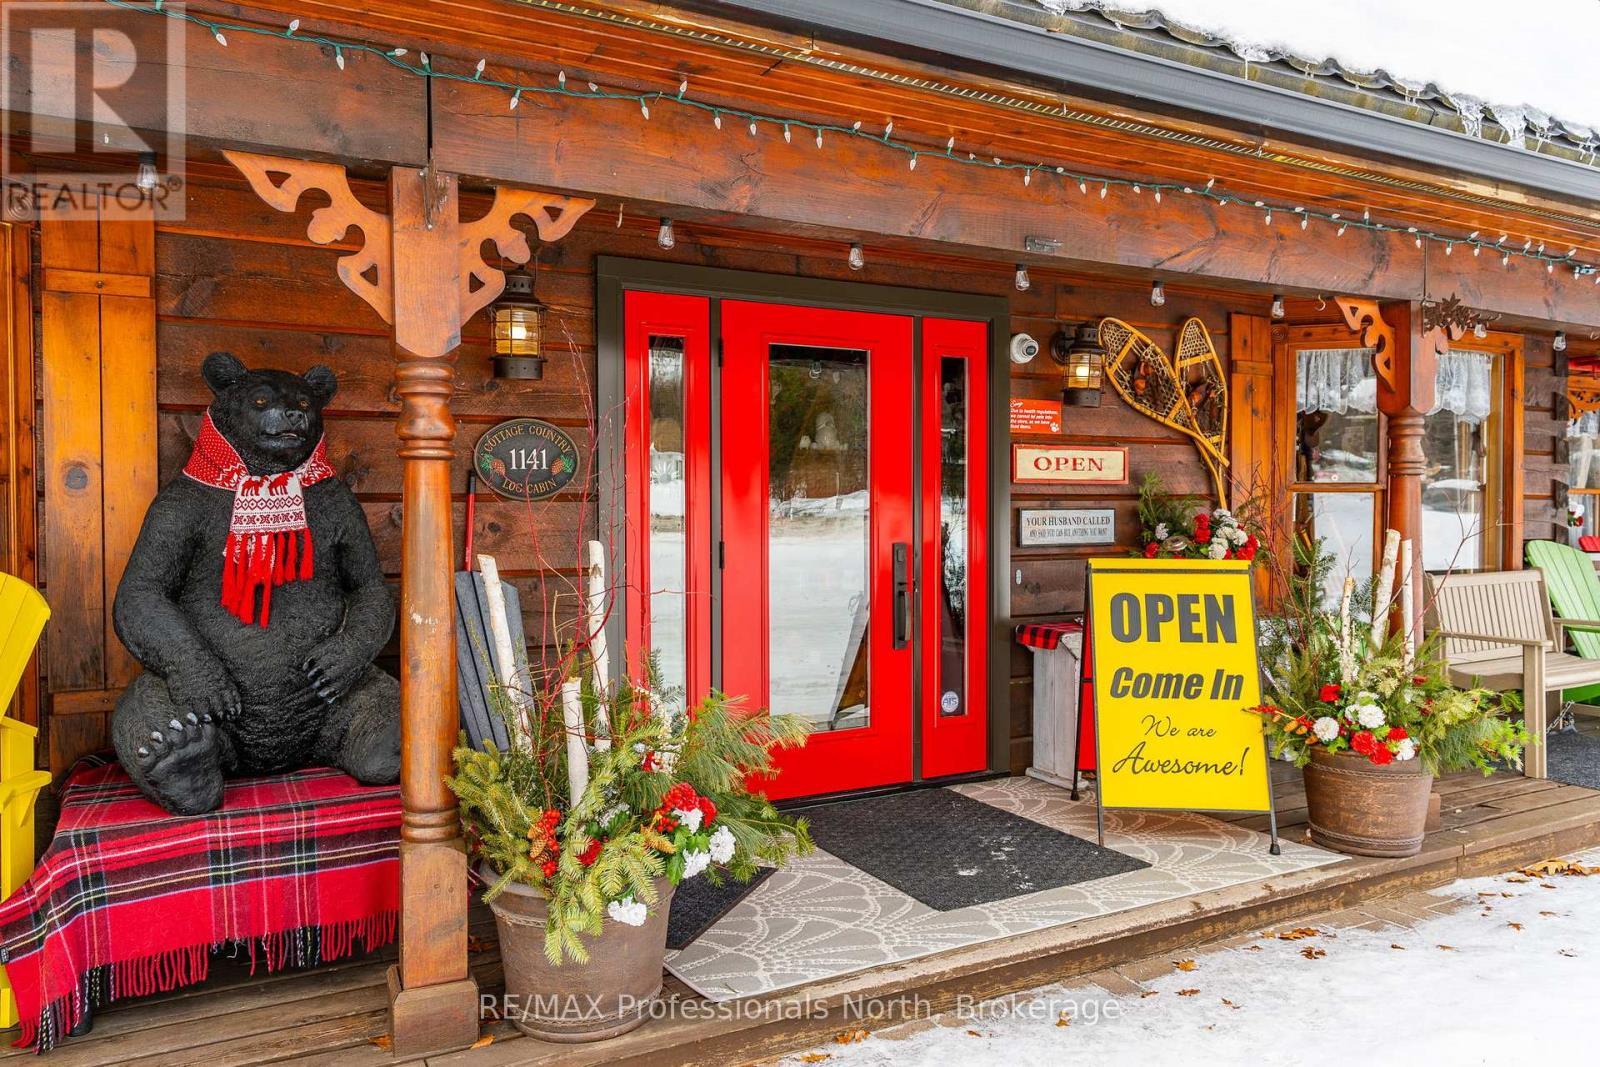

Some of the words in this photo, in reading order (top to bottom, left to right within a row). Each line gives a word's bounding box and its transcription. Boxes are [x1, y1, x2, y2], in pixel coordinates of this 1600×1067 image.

[484, 424, 525, 452] COTTAGE
[528, 424, 572, 453] COUNTRY
[509, 448, 549, 470] 1141
[1033, 456, 1104, 472] OPEN
[503, 479, 524, 493] LOG
[526, 477, 557, 494] CABIN
[1026, 516, 1047, 526] YOUR
[1048, 516, 1082, 526] HUSBAND
[1082, 516, 1111, 526] CALLED
[1109, 592, 1238, 644] OPEN
[1109, 666, 1205, 699] Come
[1210, 669, 1245, 701] In
[1141, 714, 1180, 738] We
[1186, 727, 1217, 738] are
[1112, 741, 1250, 776] Awesome!
